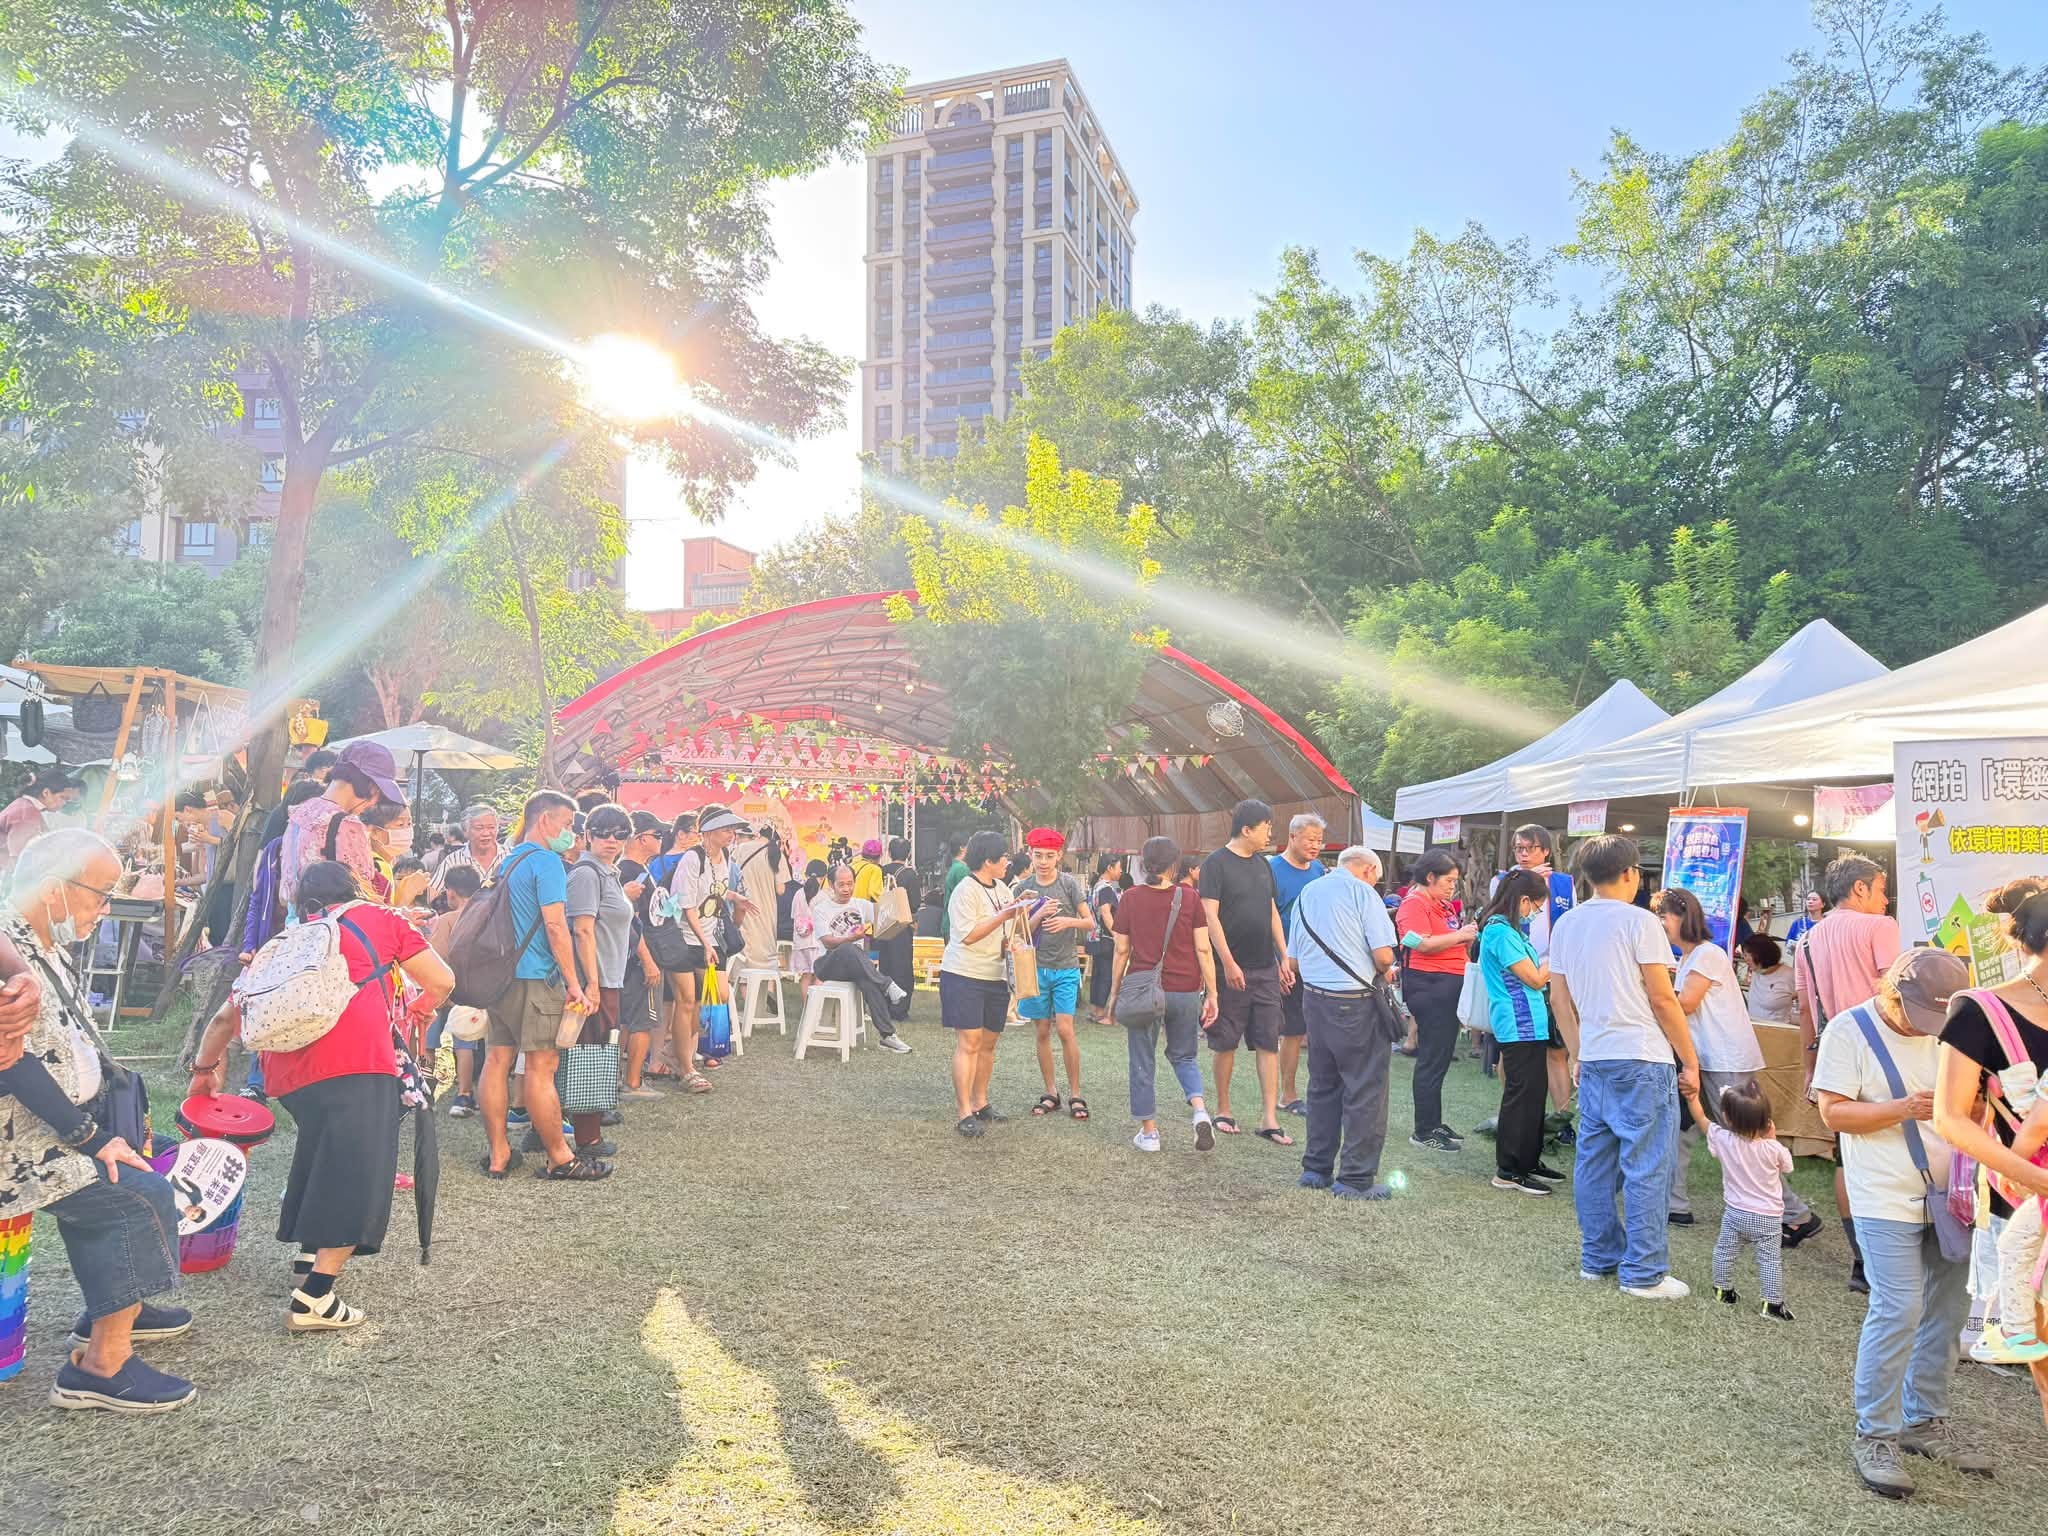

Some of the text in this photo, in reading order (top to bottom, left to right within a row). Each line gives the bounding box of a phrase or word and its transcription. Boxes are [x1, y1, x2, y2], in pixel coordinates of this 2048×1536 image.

[1948, 825, 2048, 854] 依環境用藥
